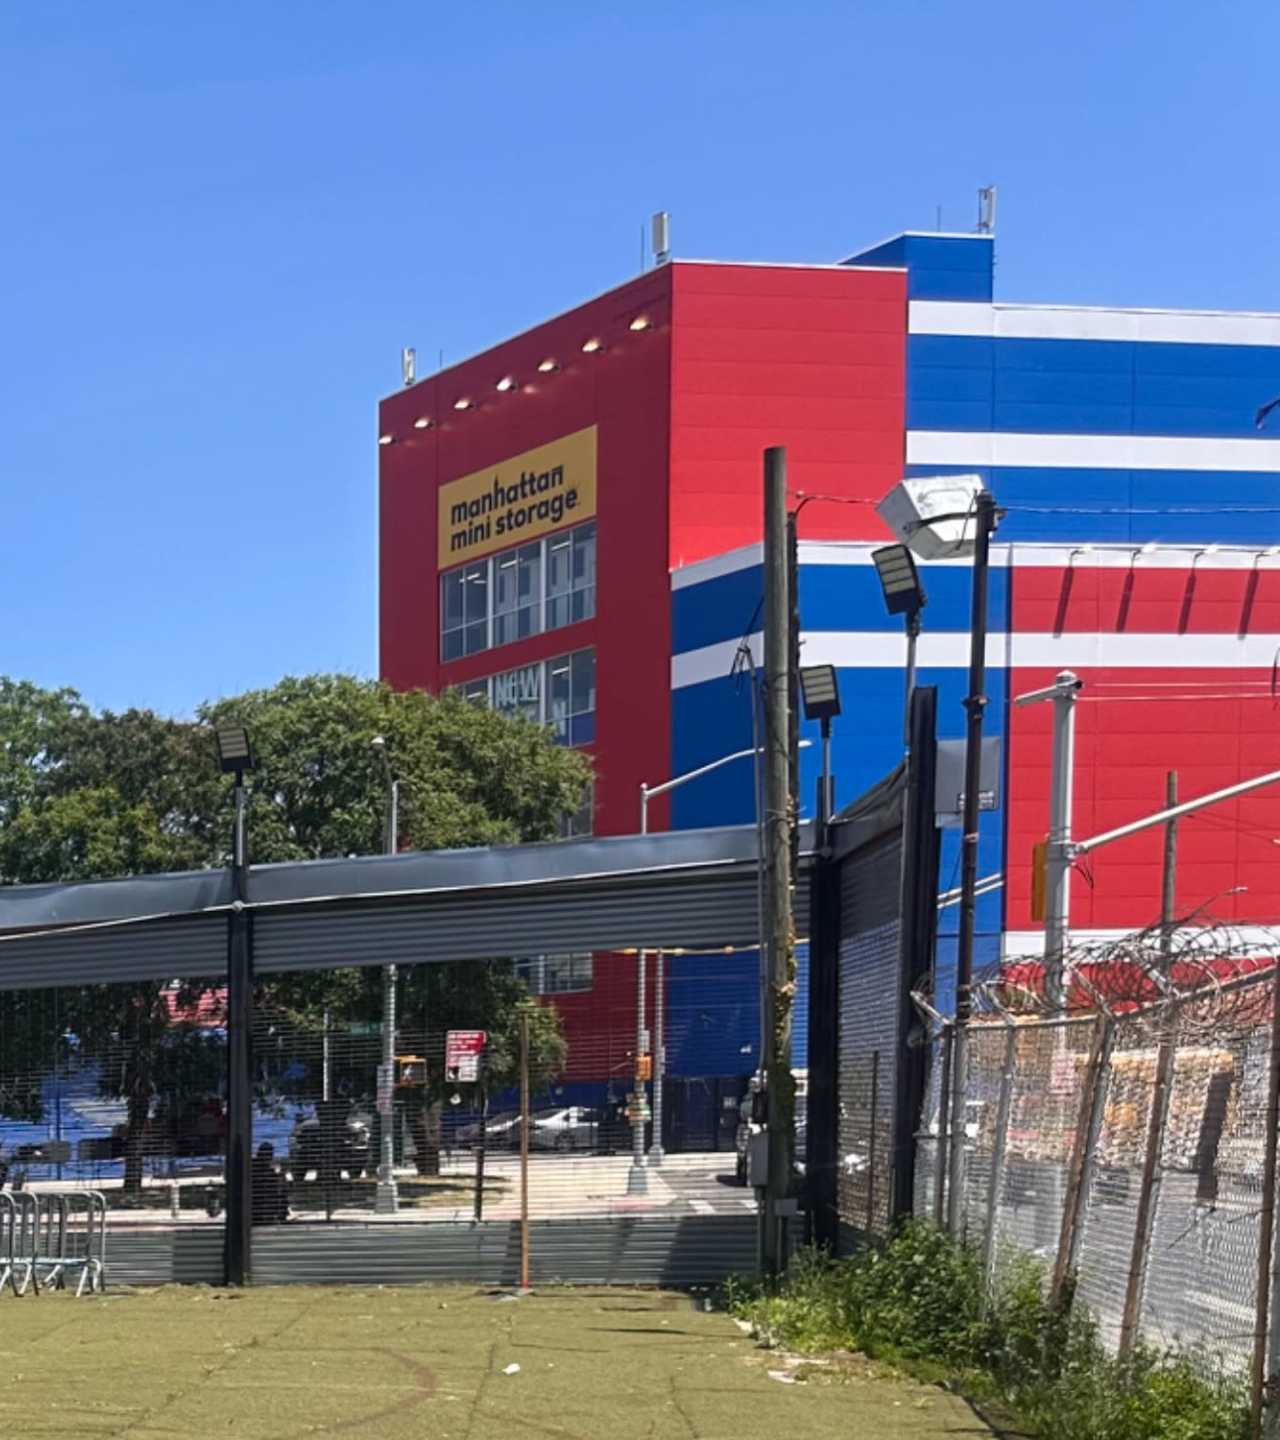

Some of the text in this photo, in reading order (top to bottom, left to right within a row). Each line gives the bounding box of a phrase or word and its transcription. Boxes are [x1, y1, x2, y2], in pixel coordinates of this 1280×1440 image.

[450, 464, 564, 525] manhattan
[450, 488, 578, 551] mini storage
